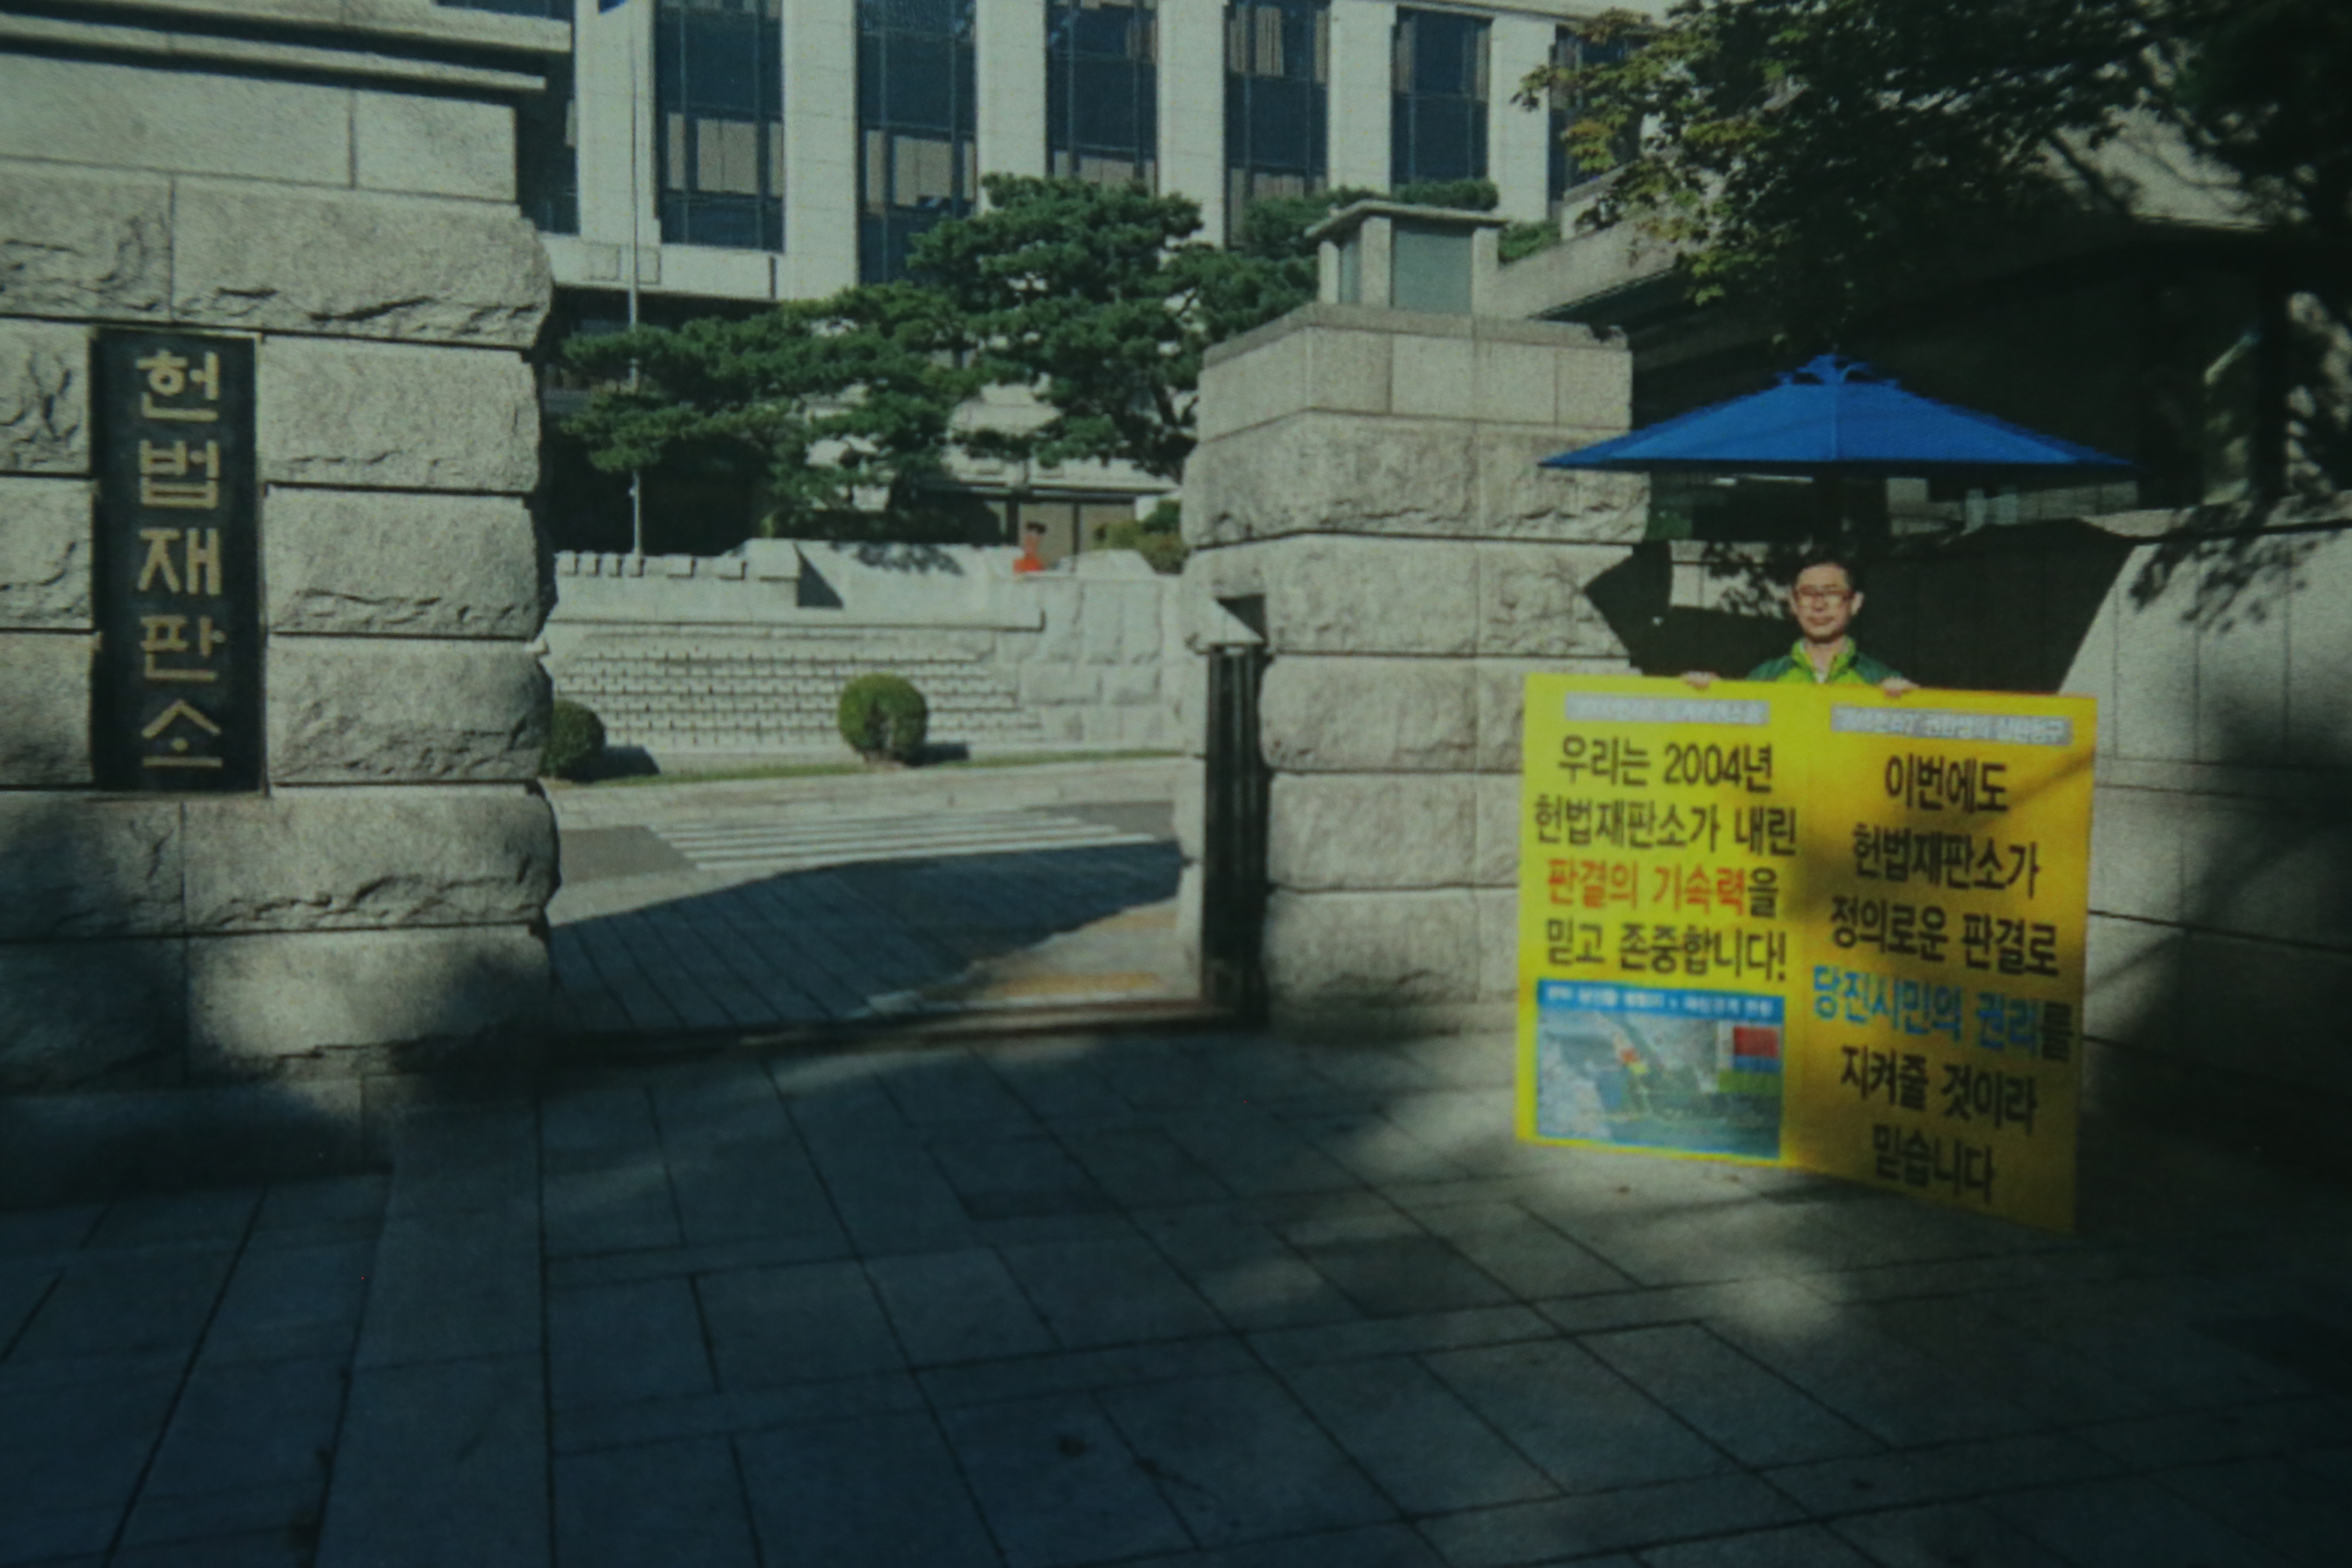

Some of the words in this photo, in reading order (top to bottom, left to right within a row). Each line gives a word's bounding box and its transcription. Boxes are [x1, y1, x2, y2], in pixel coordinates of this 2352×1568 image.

[135, 349, 225, 768] 헌법재판소
[1558, 735, 1651, 786] 우리는
[1662, 742, 1772, 794] 2004년
[1885, 752, 2008, 814] 이번에도
[1534, 794, 1720, 854] 헌법재판소가
[1734, 804, 1797, 857] 내린
[1852, 822, 2040, 900] 헌법재판소가
[1548, 858, 1638, 911] 판결의
[1653, 862, 1779, 918] 기속력을
[1547, 917, 1606, 966] 믿고
[1618, 922, 1787, 982] 존중합니다!
[1830, 895, 1949, 962] 정의로운
[1962, 913, 2059, 977] 판결로
[1813, 965, 1961, 1042] 당진시민의
[1976, 990, 2073, 1063] 권리를
[1841, 1044, 1929, 1111] 지켜줄
[1942, 1062, 2038, 1136] 것이라
[1872, 1123, 1997, 1204] 믿습니다
